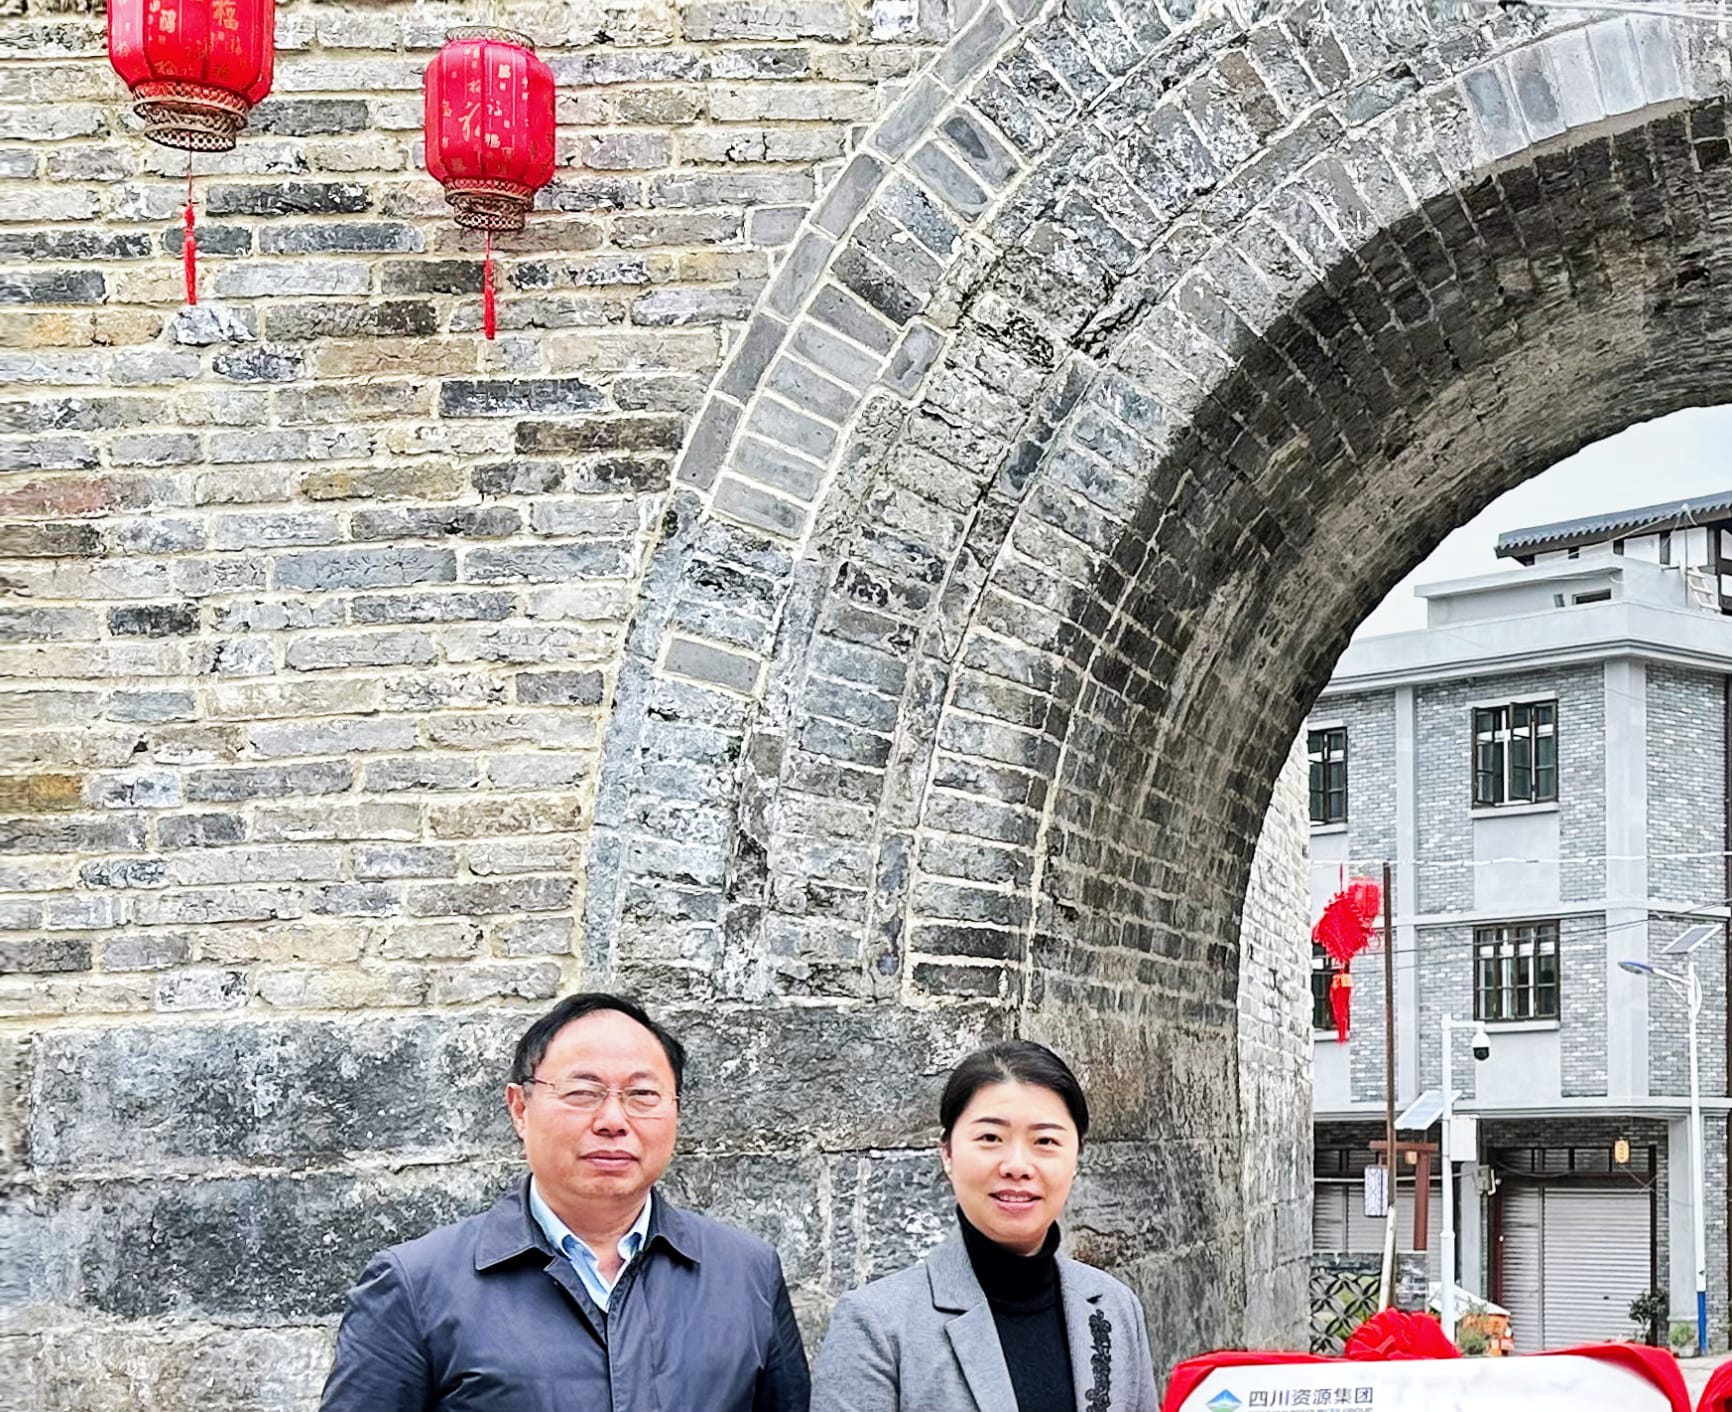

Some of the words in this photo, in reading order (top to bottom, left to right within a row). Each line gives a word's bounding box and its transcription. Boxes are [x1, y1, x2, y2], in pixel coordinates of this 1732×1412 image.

[1248, 1386, 1374, 1408] 四川资源集团
